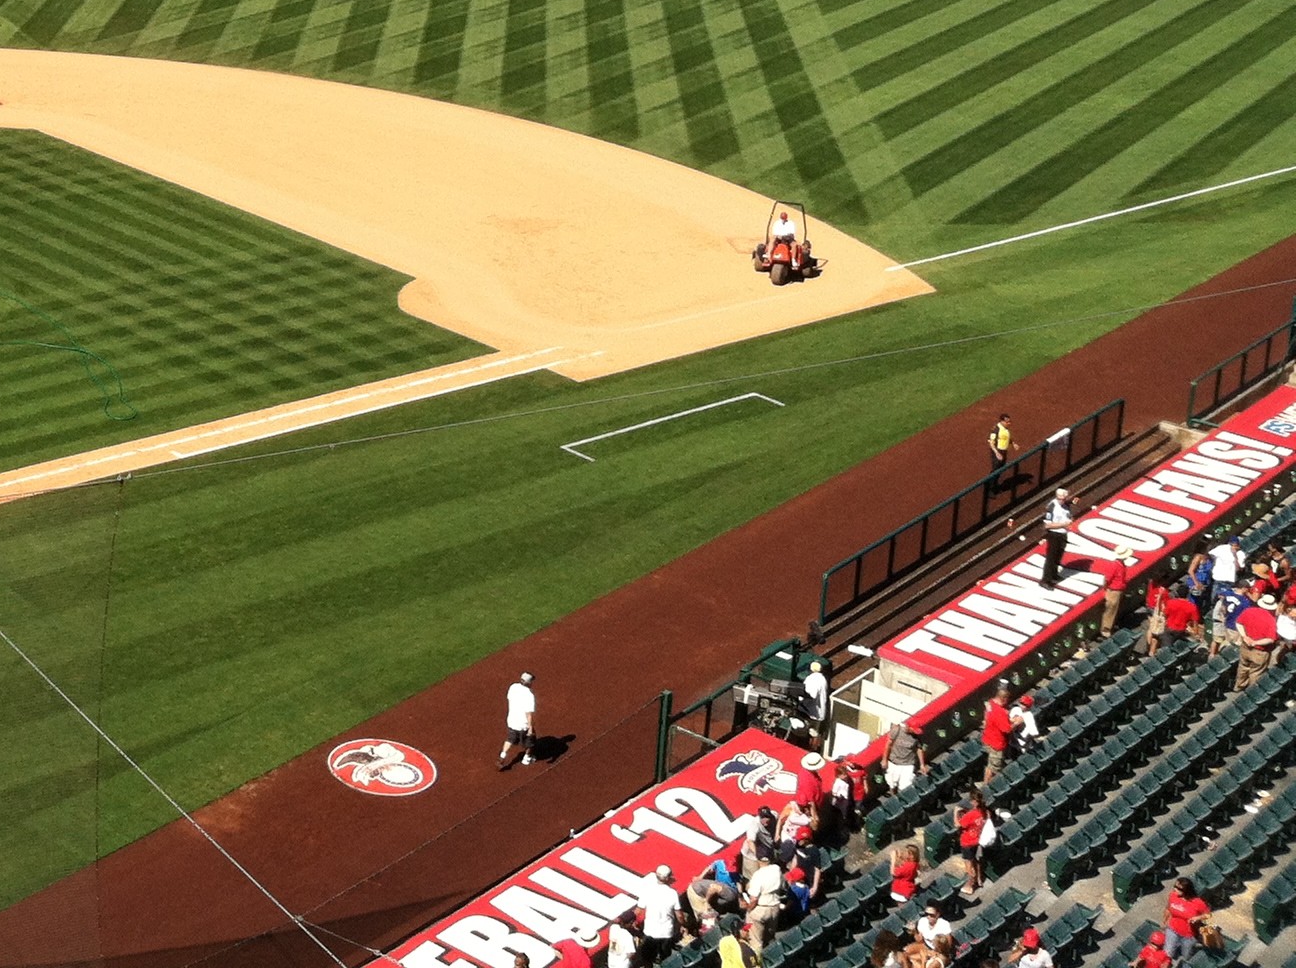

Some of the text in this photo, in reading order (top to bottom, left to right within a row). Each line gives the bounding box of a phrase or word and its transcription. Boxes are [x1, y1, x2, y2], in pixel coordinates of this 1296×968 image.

[893, 430, 1293, 672] THANK YOU FANS!
[610, 786, 760, 857] '12
